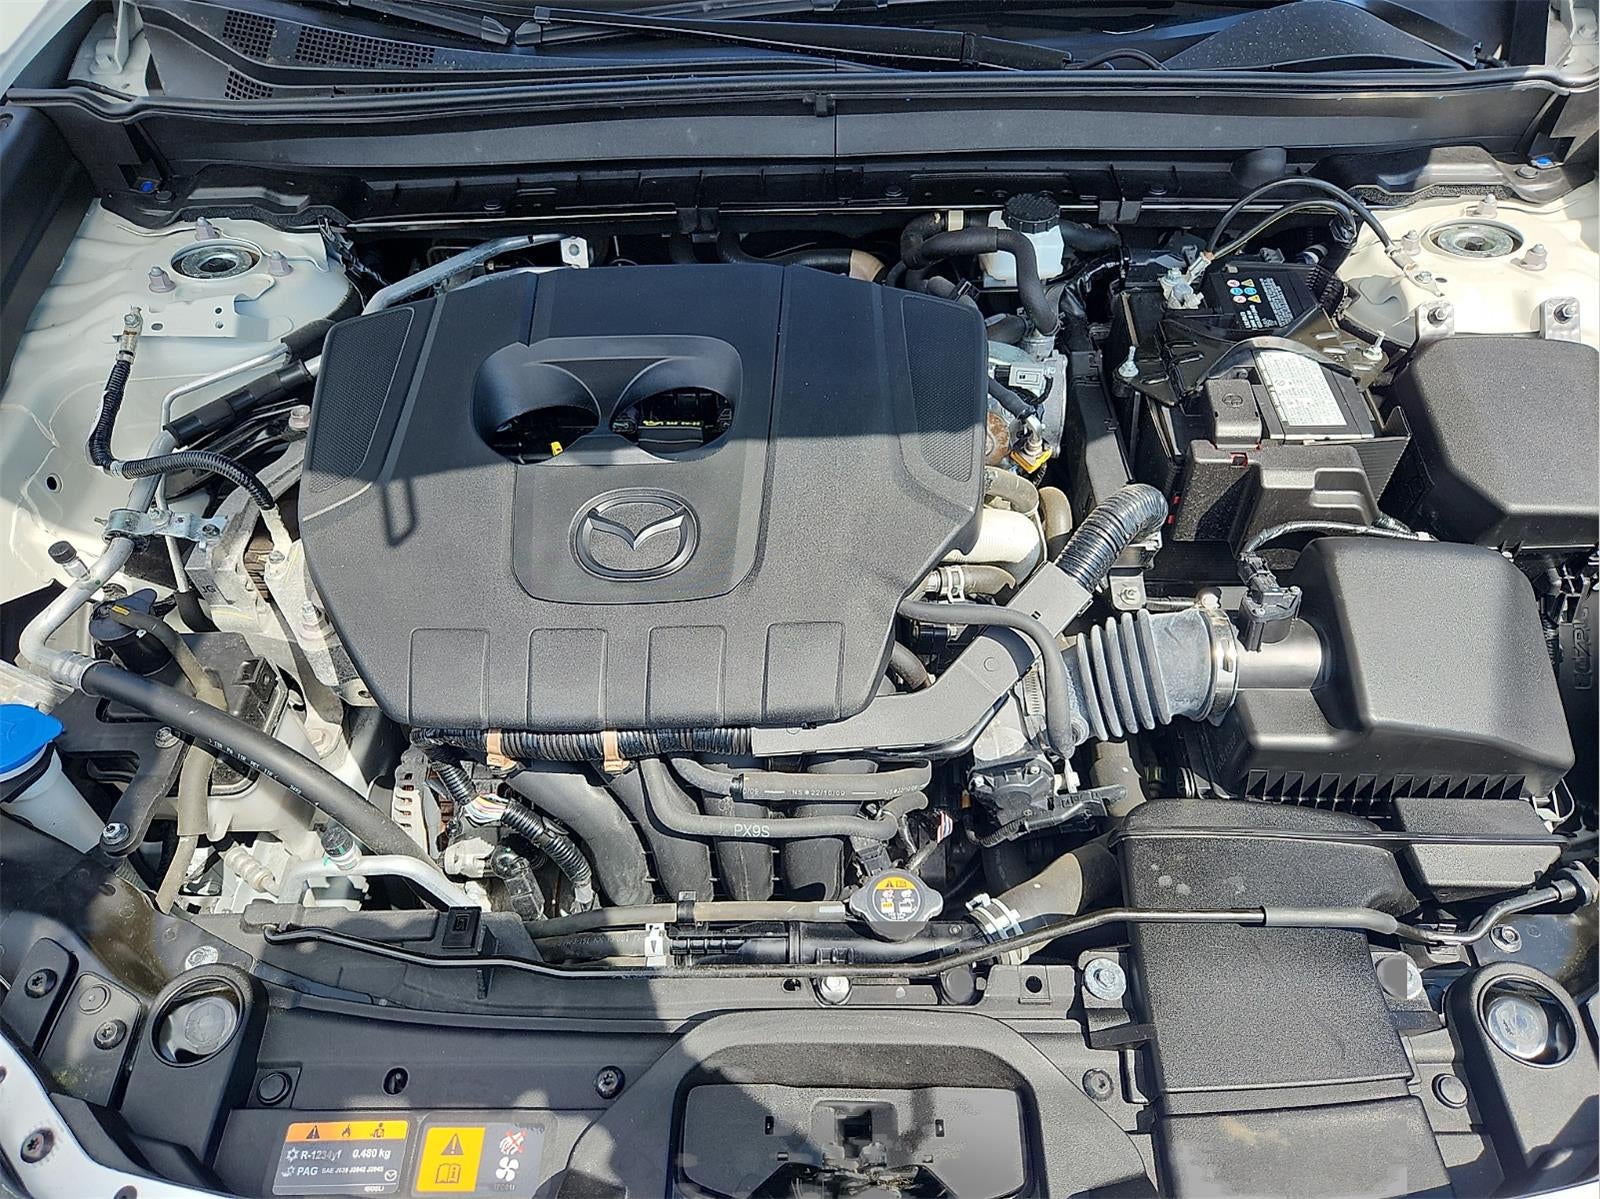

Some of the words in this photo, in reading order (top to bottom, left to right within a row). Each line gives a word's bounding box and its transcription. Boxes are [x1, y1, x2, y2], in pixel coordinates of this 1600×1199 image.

[734, 823, 770, 838] PX9S
[352, 1148, 377, 1159] 0.480
[379, 1148, 392, 1160] kg
[296, 1166, 319, 1176] PAG
